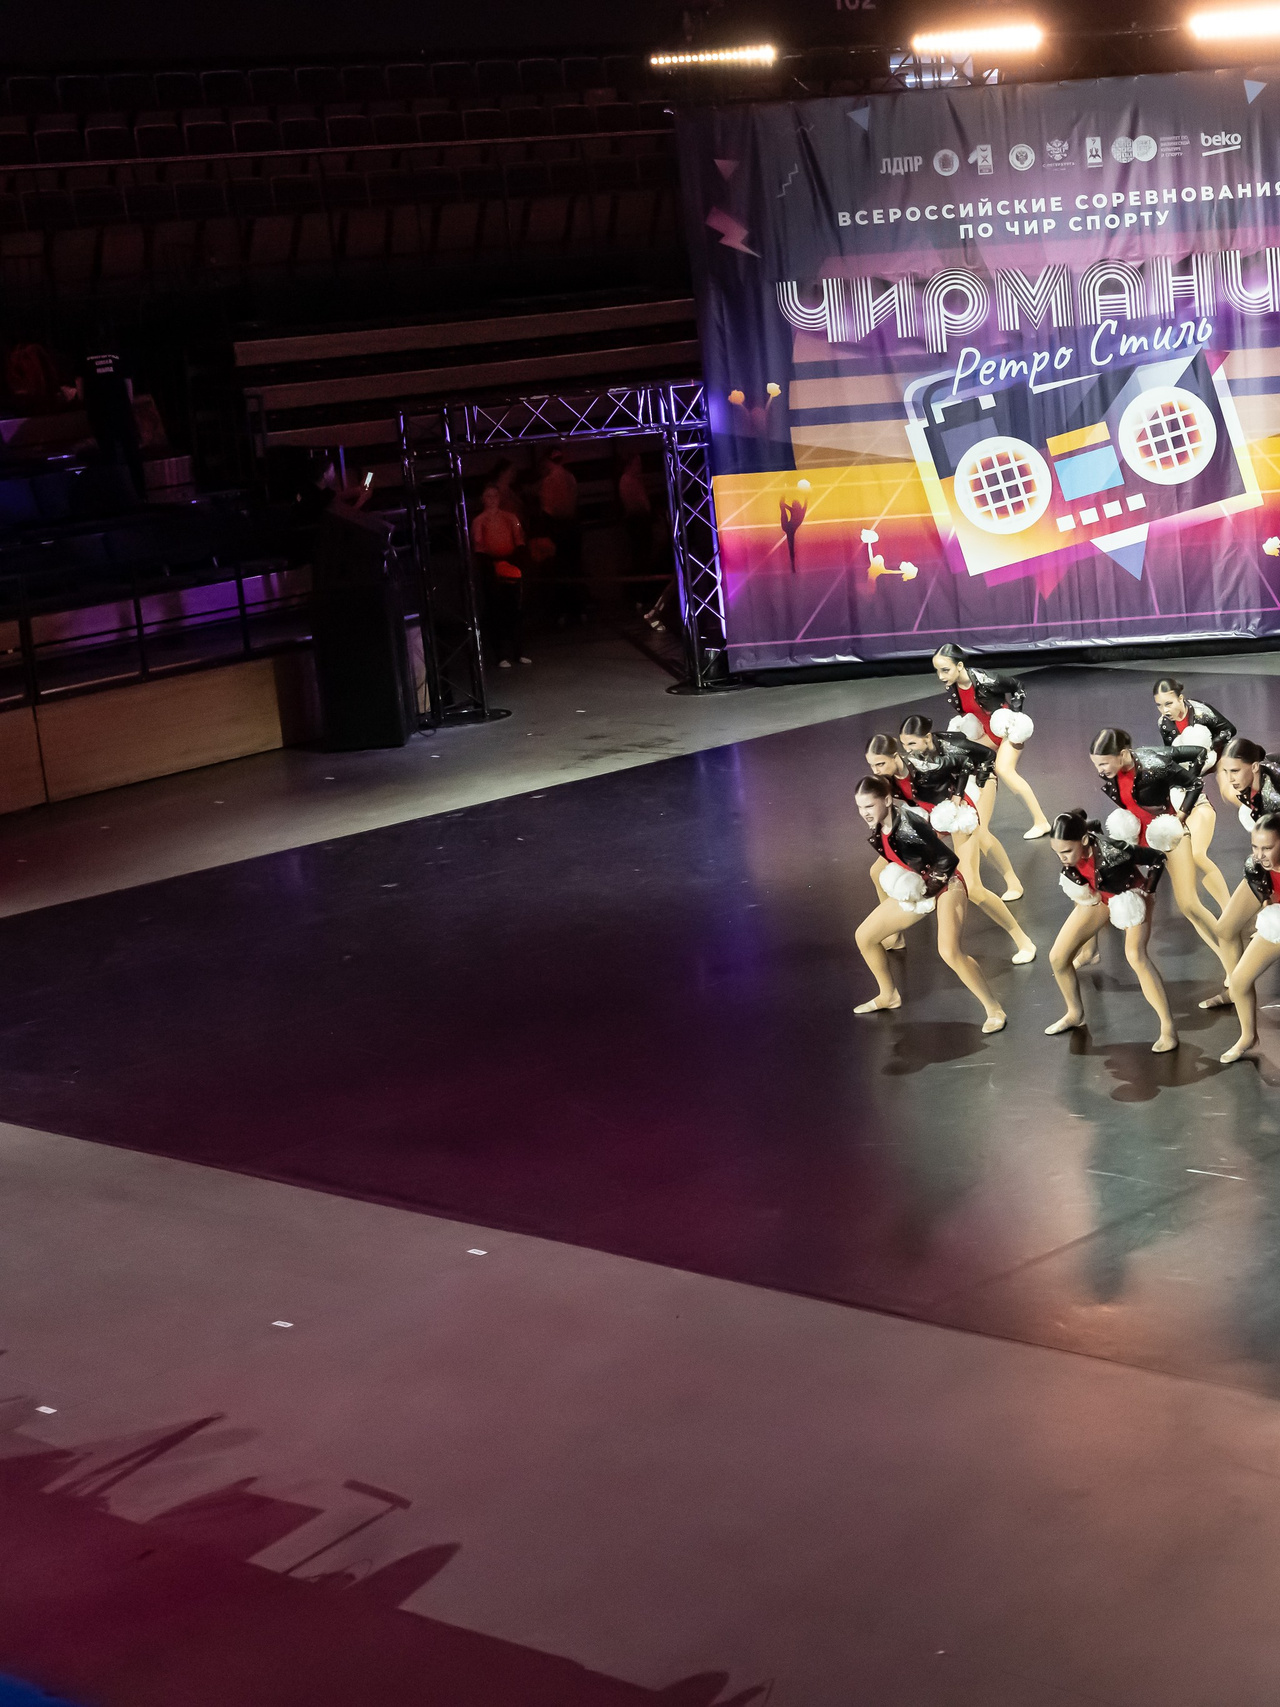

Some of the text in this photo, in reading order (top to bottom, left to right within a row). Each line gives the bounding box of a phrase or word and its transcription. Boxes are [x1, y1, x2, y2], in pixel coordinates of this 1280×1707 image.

[1200, 131, 1242, 147] beko
[880, 155, 923, 176] ЛДПР
[838, 197, 1063, 227] ВСЕРОССИЙСКИЕ
[959, 210, 1170, 240] ПО ЧИР СПОРТУ
[951, 318, 1213, 396] Ретро Стиль
